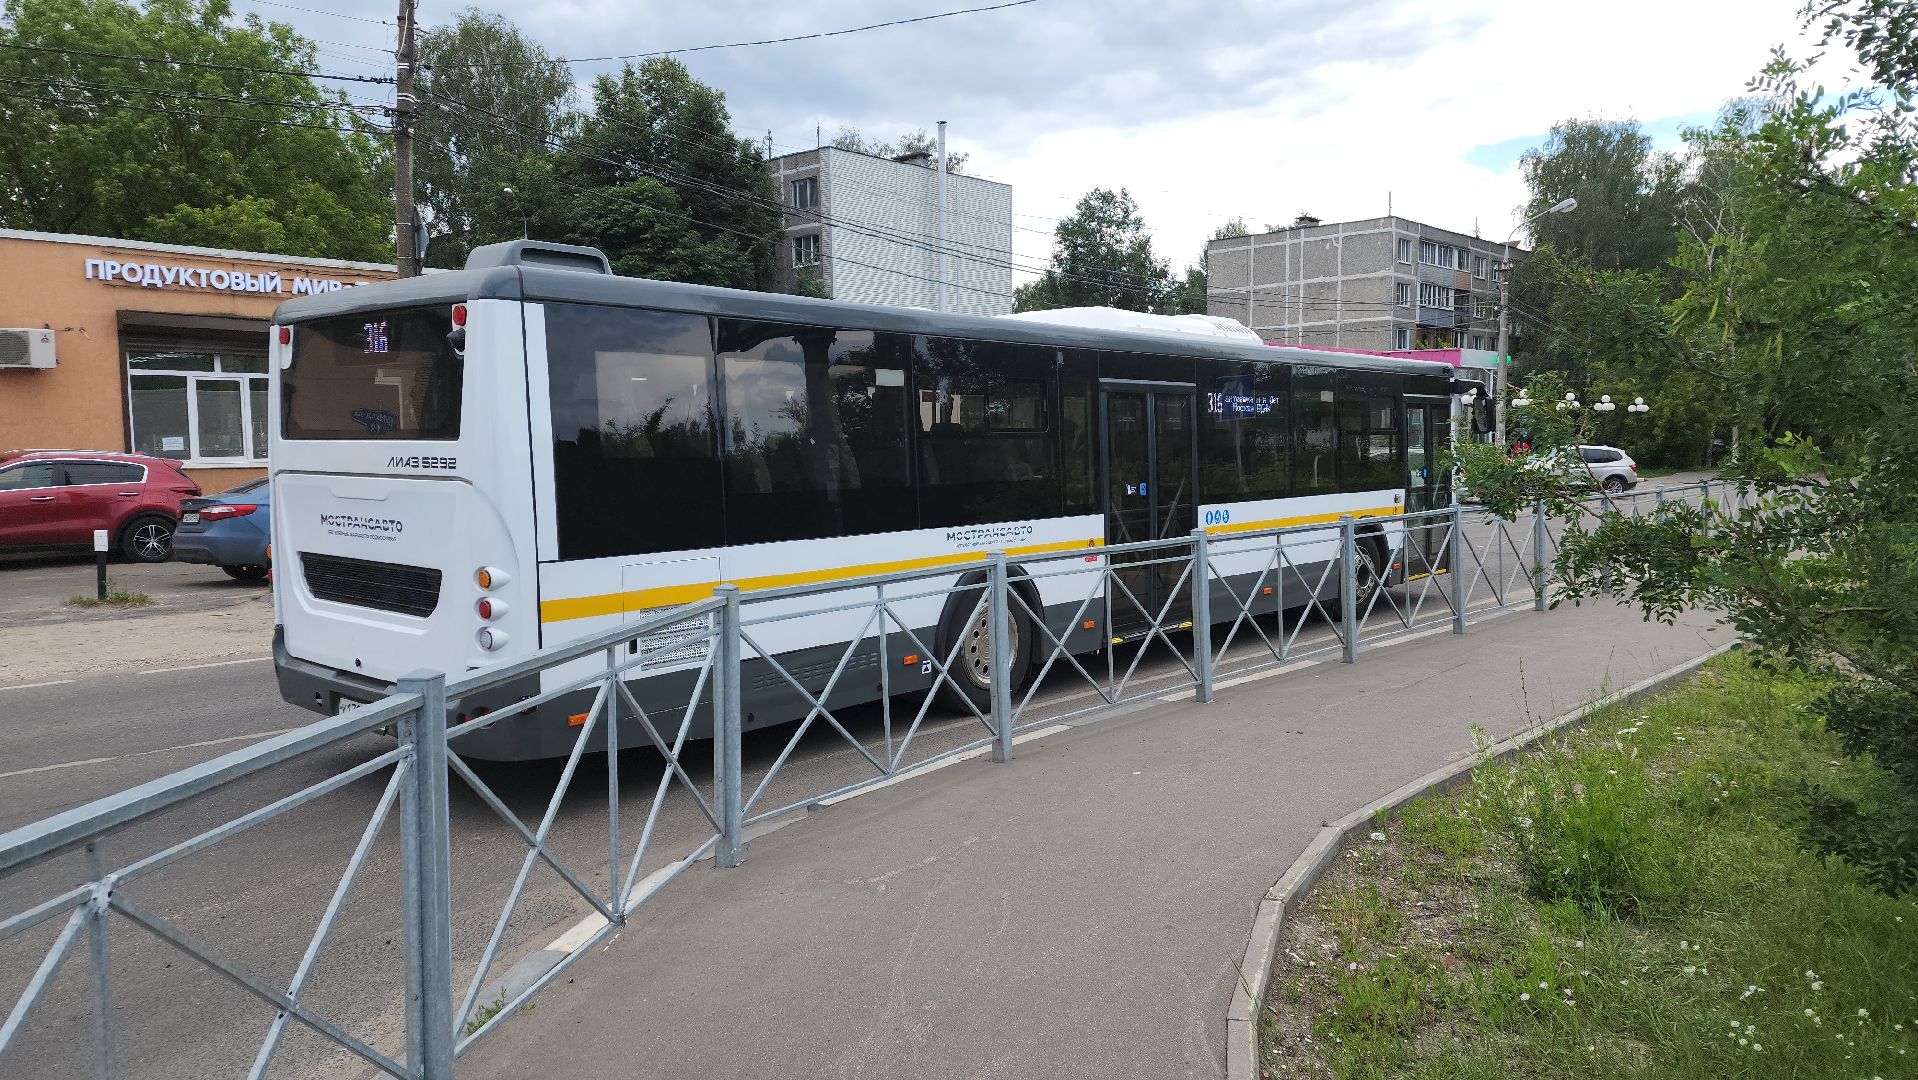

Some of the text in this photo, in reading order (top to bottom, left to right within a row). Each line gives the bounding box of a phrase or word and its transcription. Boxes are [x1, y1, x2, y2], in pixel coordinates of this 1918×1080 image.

[85, 258, 342, 296] ПРОДУКТОВЫЙ МИР
[1207, 392, 1223, 412] 316
[422, 457, 457, 469] 5292
[320, 513, 403, 532] МОСТРАНСАВТО
[946, 525, 1033, 542] МОСТРАНСАВТО
